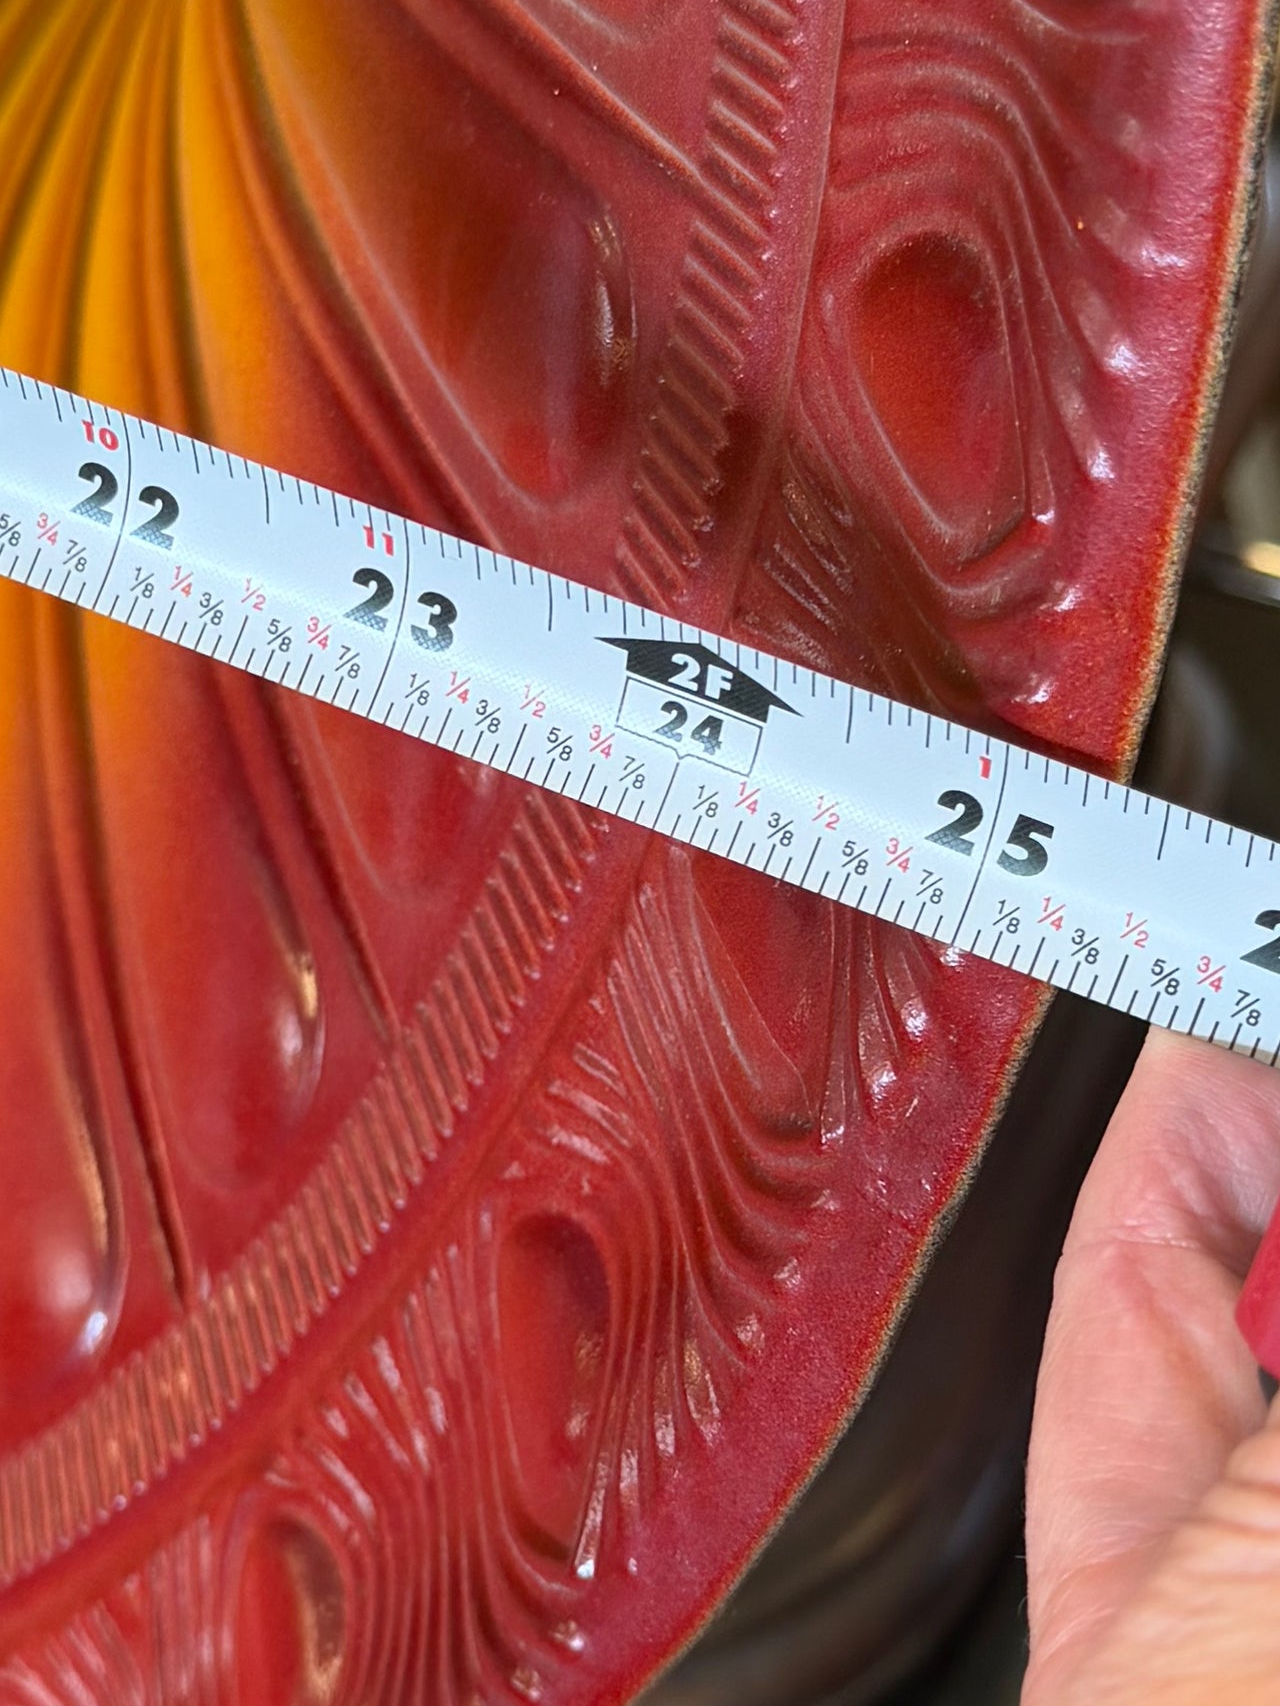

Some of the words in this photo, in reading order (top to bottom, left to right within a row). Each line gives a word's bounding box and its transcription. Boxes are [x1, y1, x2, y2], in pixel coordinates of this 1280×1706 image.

[37, 513, 61, 545] 3/4
[63, 540, 88, 572] 7/8
[130, 567, 154, 598] 1/8
[170, 565, 193, 597] 1/4
[199, 593, 223, 625] 3/8
[241, 579, 266, 610] 1/2
[267, 619, 292, 652] 5/8
[307, 617, 331, 650] 3/4
[335, 646, 360, 679] 7/8
[405, 673, 430, 705] 1/8
[446, 671, 470, 704] 1/4
[476, 700, 501, 733] 3/8
[520, 685, 546, 718] 1/2
[547, 727, 572, 761] 5/8
[589, 725, 614, 758] 3/4
[619, 756, 645, 789] 7/8
[692, 785, 719, 819] 1/8
[735, 782, 760, 815] 1/4
[768, 813, 794, 847] 3/8
[813, 796, 840, 830] 1/2
[842, 841, 869, 875] 5/8
[886, 838, 912, 872] 3/4
[917, 870, 943, 904] 7/8
[992, 900, 1020, 935] 1/8
[1037, 896, 1067, 931] 1/4
[1071, 929, 1100, 965] 3/8
[1120, 912, 1149, 948] 1/2
[1151, 959, 1181, 996] 5/8
[1196, 956, 1226, 993] 3/4
[1231, 990, 1261, 1027] 7/8
[71, 462, 179, 551] 22
[344, 568, 458, 652] 23
[654, 701, 724, 755] 24
[925, 789, 1055, 877] 25
[82, 420, 119, 450] 10
[363, 525, 394, 556] 11
[979, 756, 992, 779] 1
[668, 653, 734, 699] 2F
